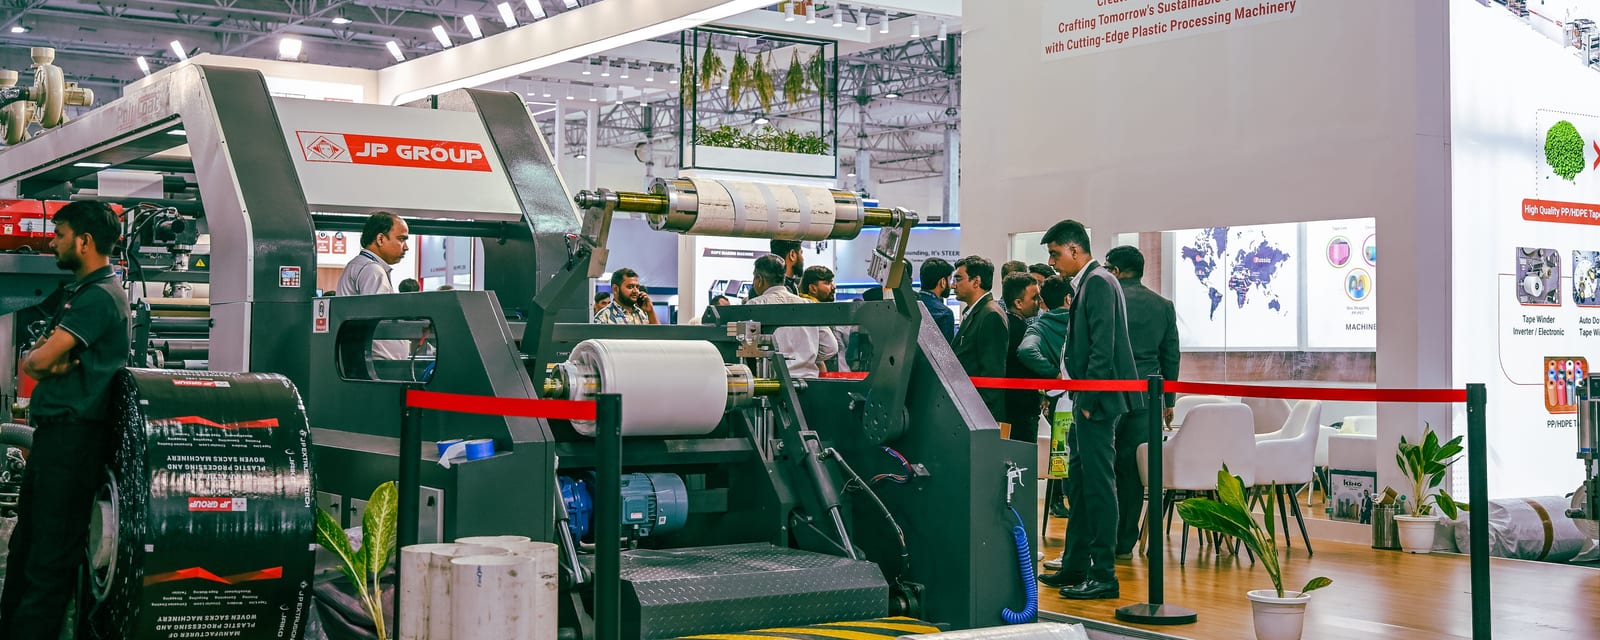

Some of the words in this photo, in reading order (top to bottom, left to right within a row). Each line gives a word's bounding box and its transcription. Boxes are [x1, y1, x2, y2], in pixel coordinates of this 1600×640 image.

[1058, 18, 1096, 33] Crafting
[1098, 5, 1155, 25] Tomorrow's
[1045, 41, 1065, 55] with
[1066, 30, 1129, 50] Cutting-Edge
[1132, 22, 1168, 39] Plastic
[1170, 12, 1232, 32] Processing
[1234, 0, 1297, 20] Machinery
[356, 142, 389, 158] JP
[396, 145, 483, 164] GROUP
[1524, 204, 1539, 216] High
[1540, 205, 1560, 218] Quality
[1561, 207, 1588, 218] PP/HDPE
[1589, 209, 1600, 221] Tap
[1522, 315, 1535, 325] Tape
[1536, 315, 1555, 324] Winder
[1579, 316, 1591, 324] Auto
[1513, 328, 1534, 336] Inverter
[1538, 328, 1565, 336] Electronic
[1579, 328, 1592, 338] Tape
[1547, 419, 1573, 429] PP/HDPE
[184, 463, 232, 471] PROCESSING
[189, 500, 219, 508] GROUP
[220, 500, 231, 508] JP
[157, 615, 203, 623] MACHINERY
[179, 630, 241, 638] MANUFACTURER
